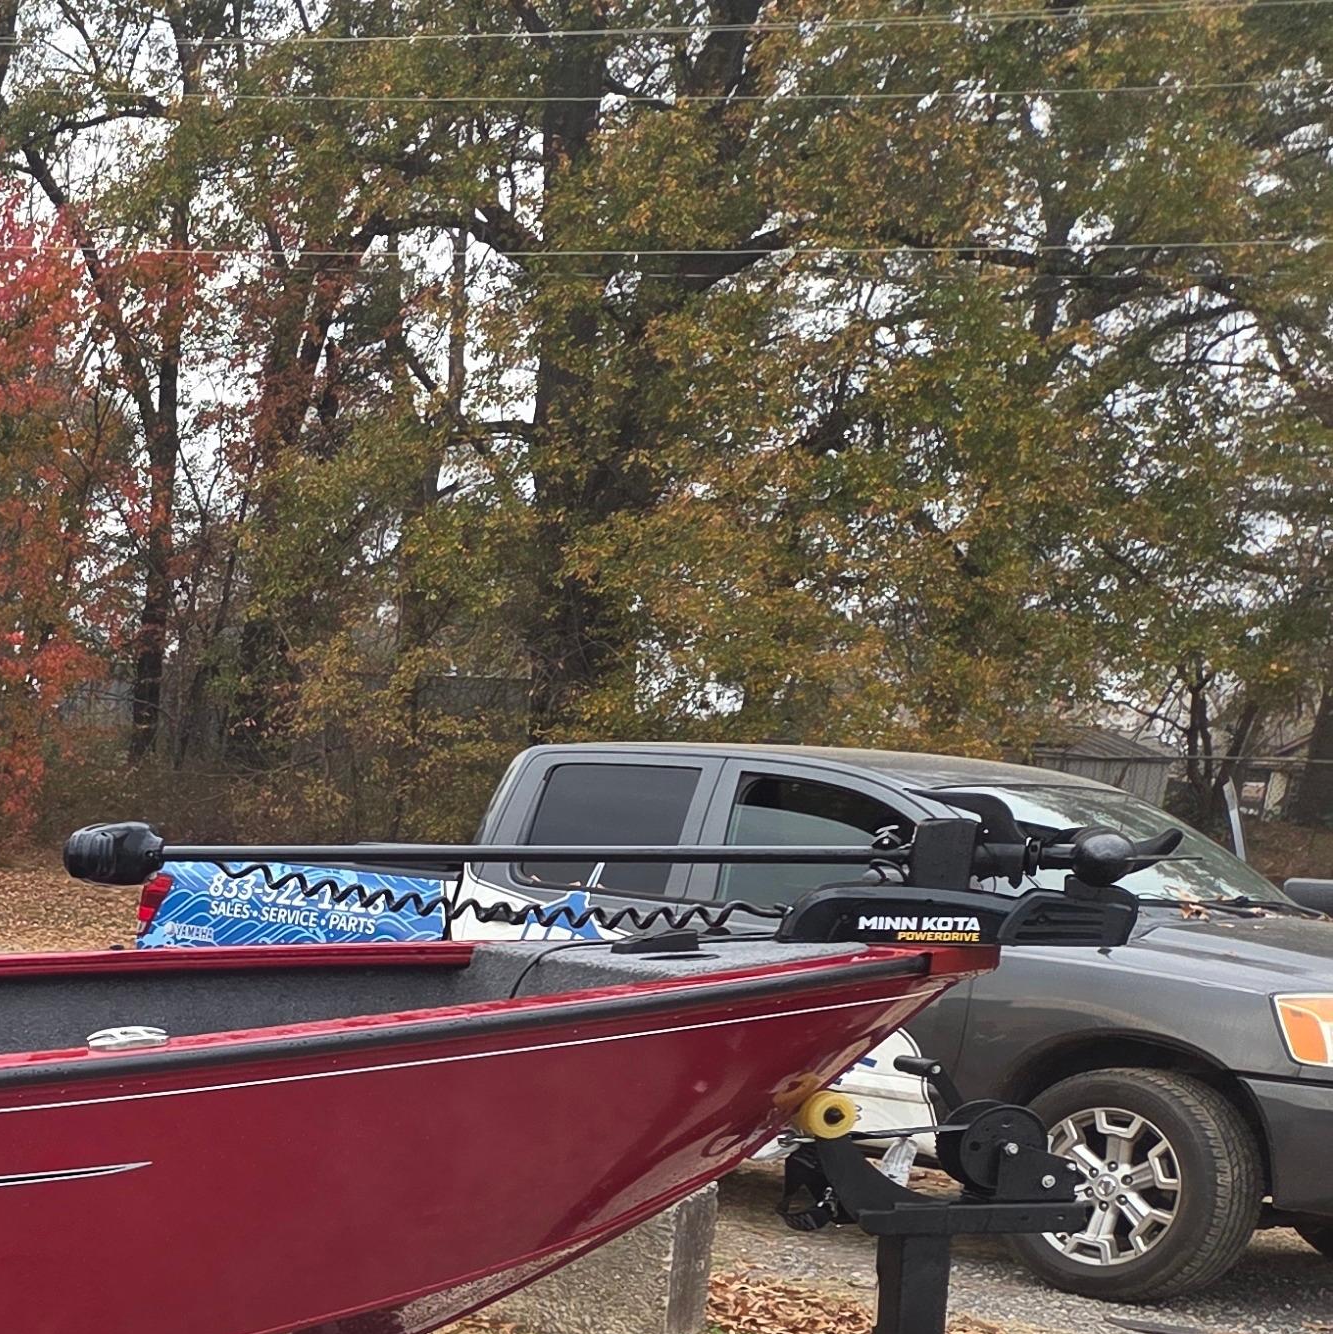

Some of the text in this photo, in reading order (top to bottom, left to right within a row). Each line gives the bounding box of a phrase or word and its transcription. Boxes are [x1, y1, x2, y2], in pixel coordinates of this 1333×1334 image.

[209, 901, 376, 935] SALES SERVICE PARTS
[858, 916, 981, 931] MINN KOTA
[175, 924, 214, 940] YAMAHA
[897, 931, 980, 941] POWERDRIVE
